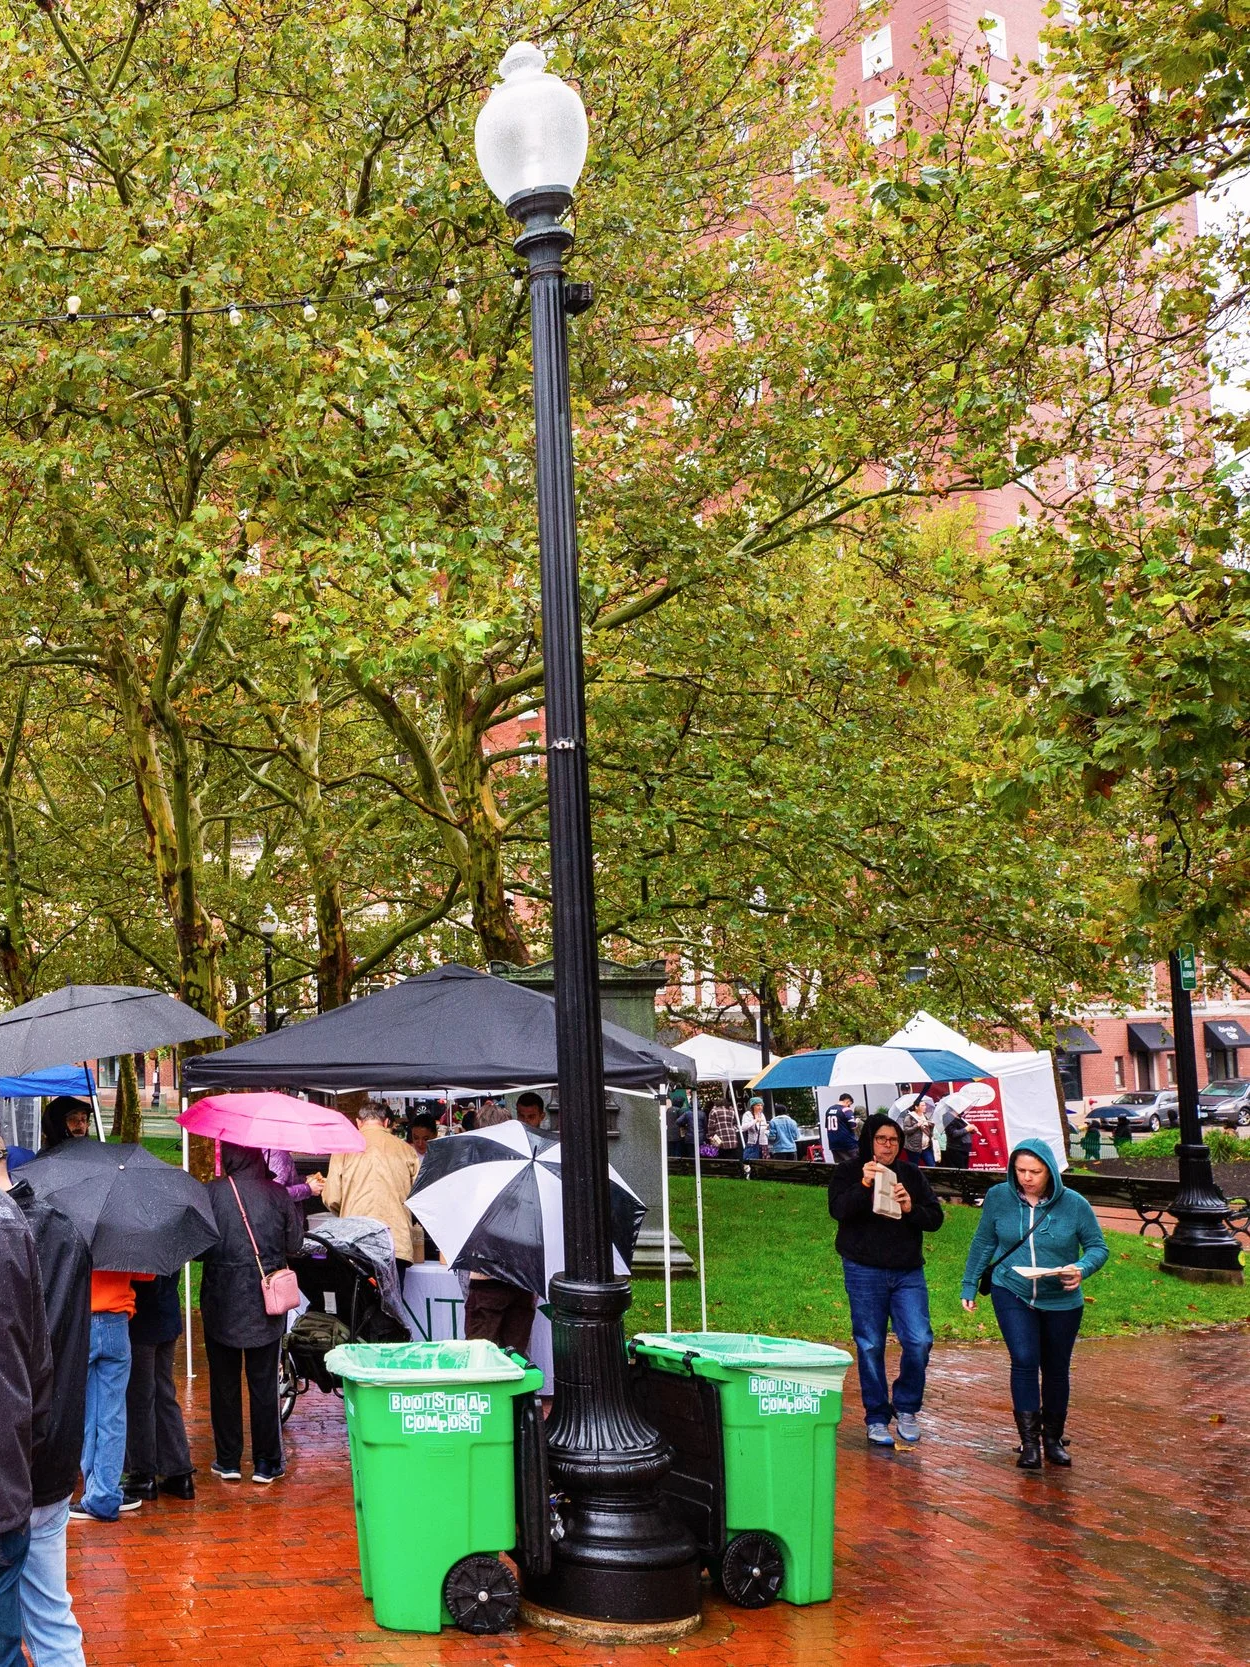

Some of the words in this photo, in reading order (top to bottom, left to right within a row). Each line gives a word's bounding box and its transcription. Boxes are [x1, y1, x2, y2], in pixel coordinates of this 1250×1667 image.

[827, 1115, 838, 1131] 10
[389, 1392, 491, 1414] BOOTSTRAP
[759, 1394, 820, 1415] COMPOST
[402, 1411, 482, 1434] COMPOST
